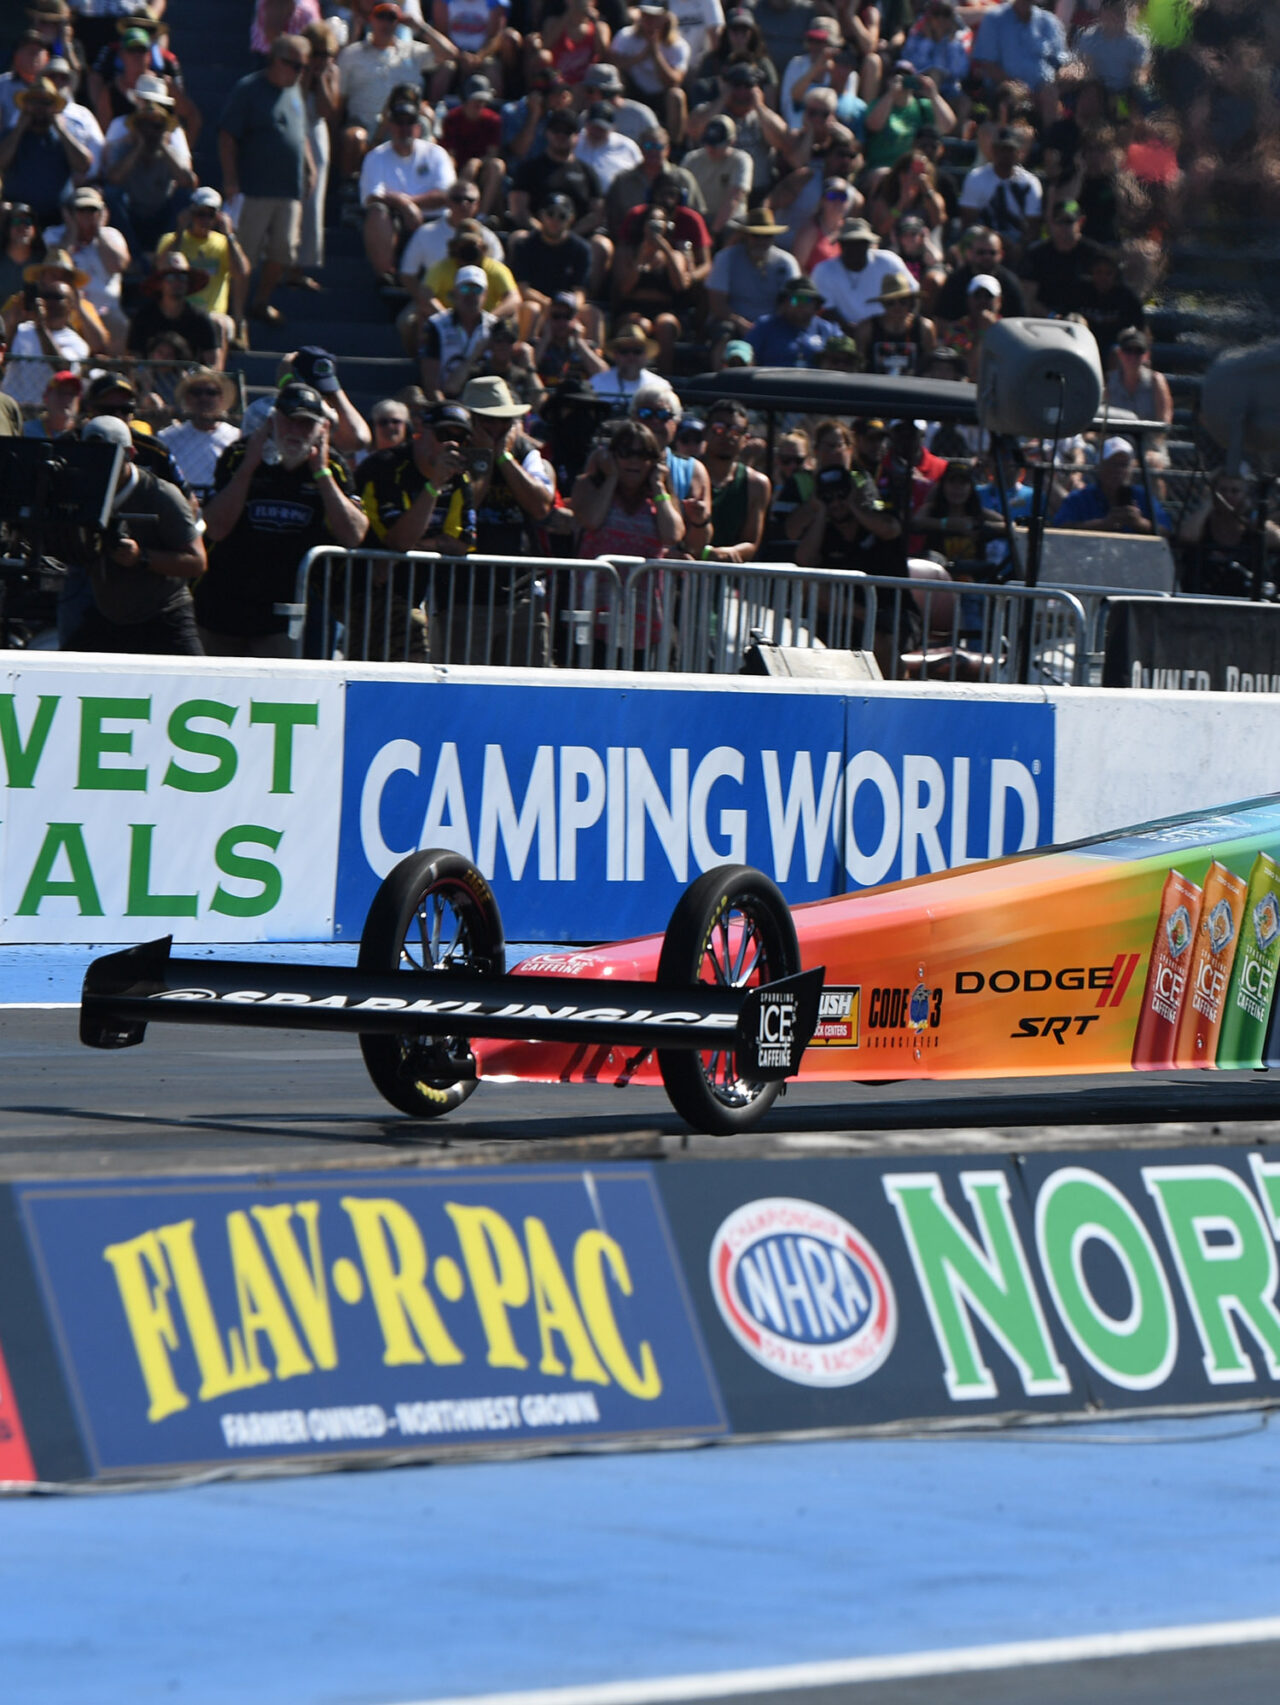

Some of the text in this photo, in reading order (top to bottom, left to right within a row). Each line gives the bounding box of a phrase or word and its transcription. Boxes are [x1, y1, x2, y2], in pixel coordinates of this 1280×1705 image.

[360, 738, 1039, 886] CAMPING WORLD
[955, 967, 1114, 994] DODGE
[1155, 963, 1184, 1002] ICE
[1196, 959, 1225, 1000] ICE
[1241, 955, 1273, 999] ICE
[760, 993, 795, 1003] SPARKLING
[819, 991, 854, 1016] USH
[868, 988, 943, 1028] CODE 3
[1152, 996, 1177, 1024] CAFFEINE
[1192, 993, 1218, 1024] CAFFEINE
[1237, 991, 1264, 1022] CAFFEINE
[760, 1004, 793, 1042] ICE
[1010, 1015, 1100, 1045] SRT
[758, 1049, 791, 1067] CAFFEINE
[740, 1236, 869, 1338] NHRA
[220, 1408, 308, 1448] FARMER
[520, 1391, 600, 1427] GROWN
